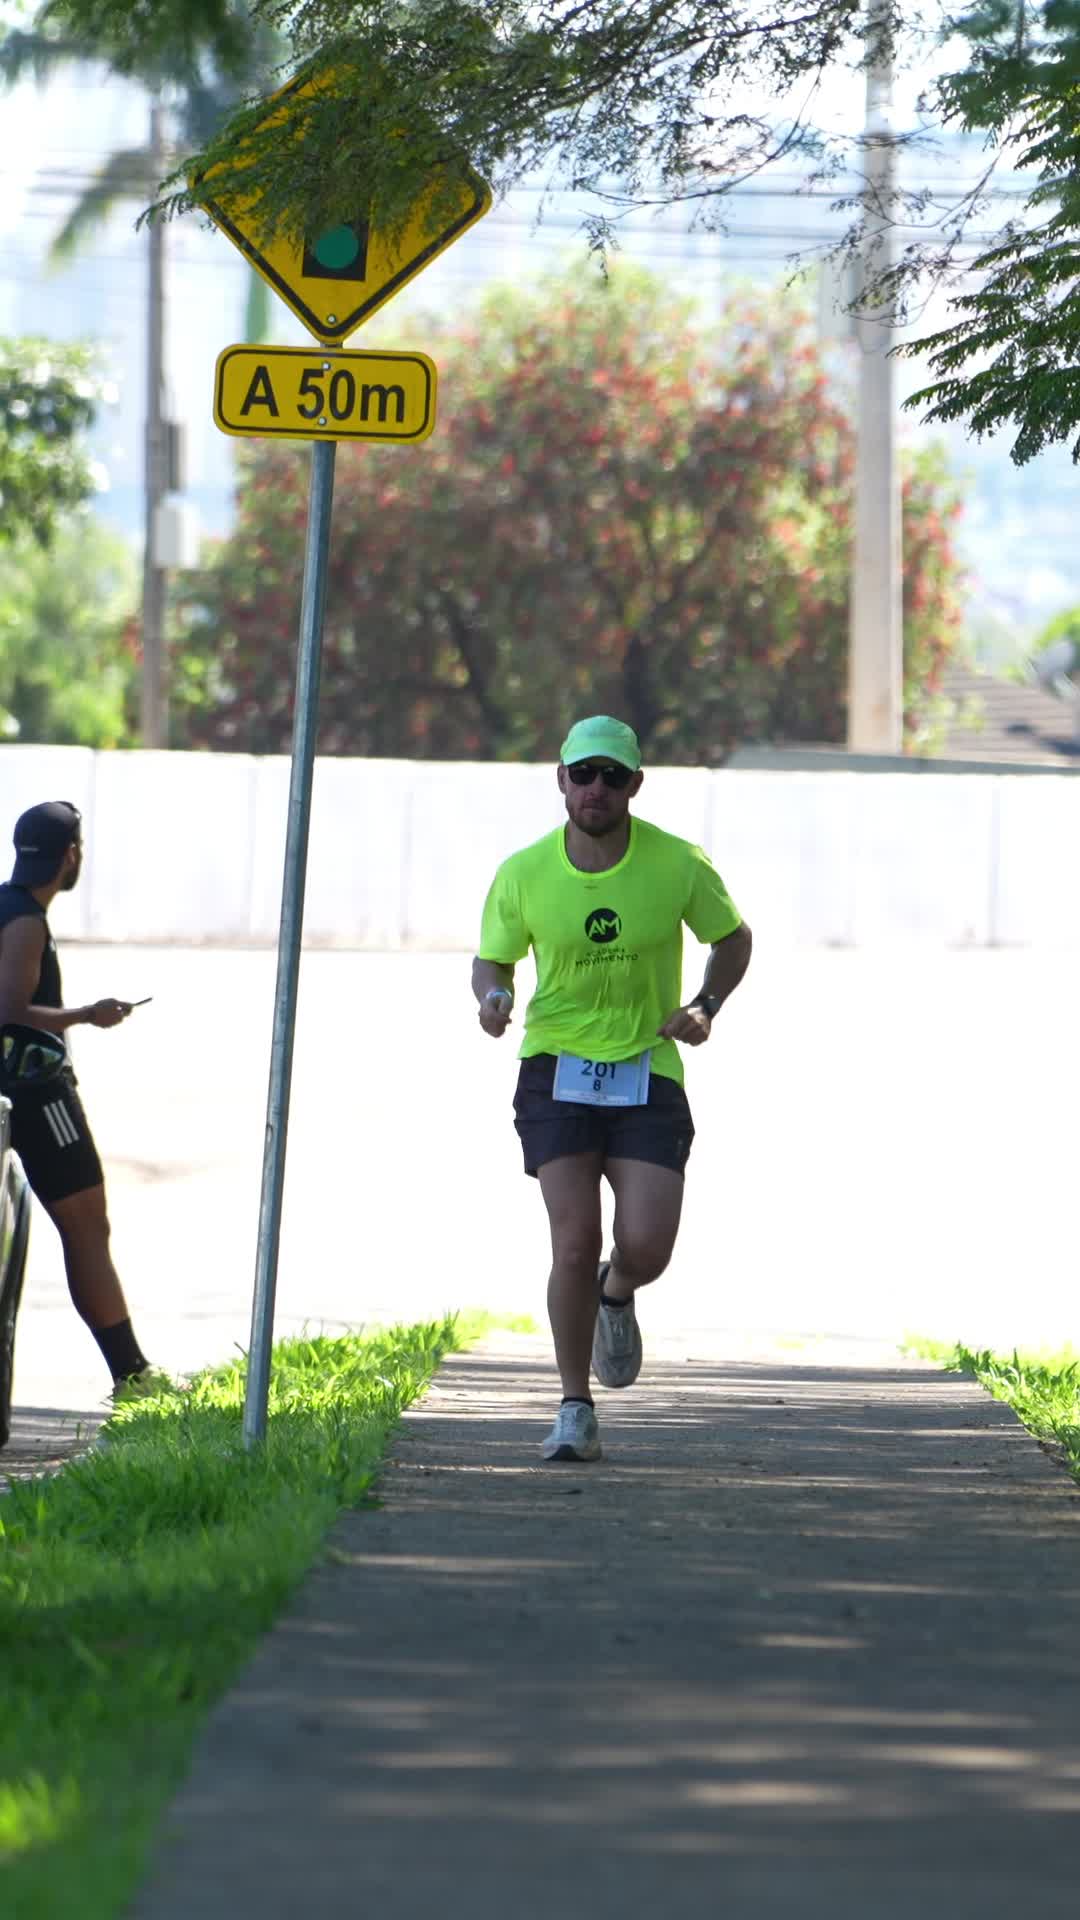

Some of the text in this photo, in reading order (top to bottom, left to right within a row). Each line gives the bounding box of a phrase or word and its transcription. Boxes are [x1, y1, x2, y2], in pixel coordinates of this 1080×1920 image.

[240, 365, 405, 422] A 50m
[588, 917, 619, 937] AM
[575, 953, 639, 967] MOVIMENTO
[581, 1060, 616, 1079] 201
[593, 1080, 601, 1091] 8
